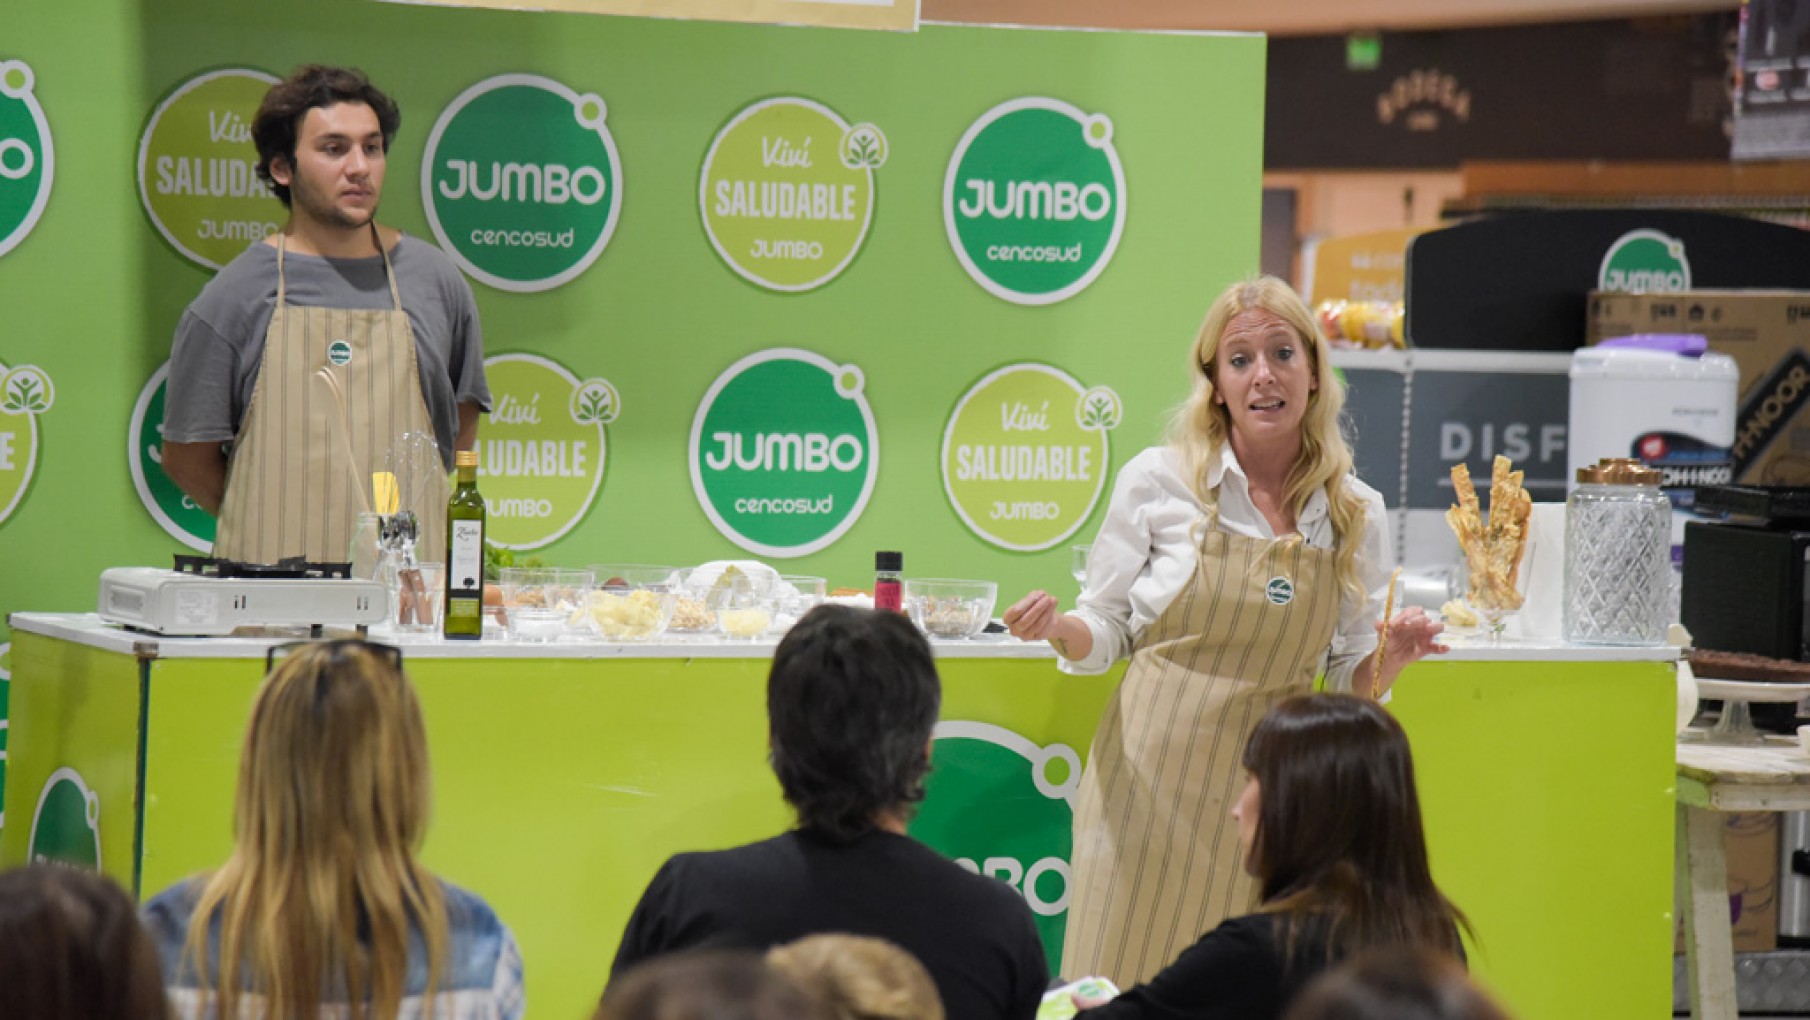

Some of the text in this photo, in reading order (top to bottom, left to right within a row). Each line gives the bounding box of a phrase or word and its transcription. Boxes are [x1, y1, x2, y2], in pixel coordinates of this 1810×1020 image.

[209, 111, 252, 142] Viv
[762, 136, 813, 168] Viví
[156, 155, 277, 199] SALUDA
[439, 159, 606, 205] JUMBO
[715, 179, 857, 221] SALUDABLE
[959, 179, 1111, 221] JUMBO
[470, 228, 574, 248] cencosud
[750, 239, 823, 260] JUMBO
[987, 241, 1082, 263] cencosud
[1606, 268, 1684, 293] JUMBO
[489, 393, 542, 425] Viví
[1001, 401, 1051, 432] Viví
[474, 439, 587, 478] LUDABLE
[705, 432, 864, 472] JUMBO
[957, 444, 1092, 481] SALUDABLE
[735, 493, 834, 514] cencosud
[990, 501, 1060, 520] JUMBO
